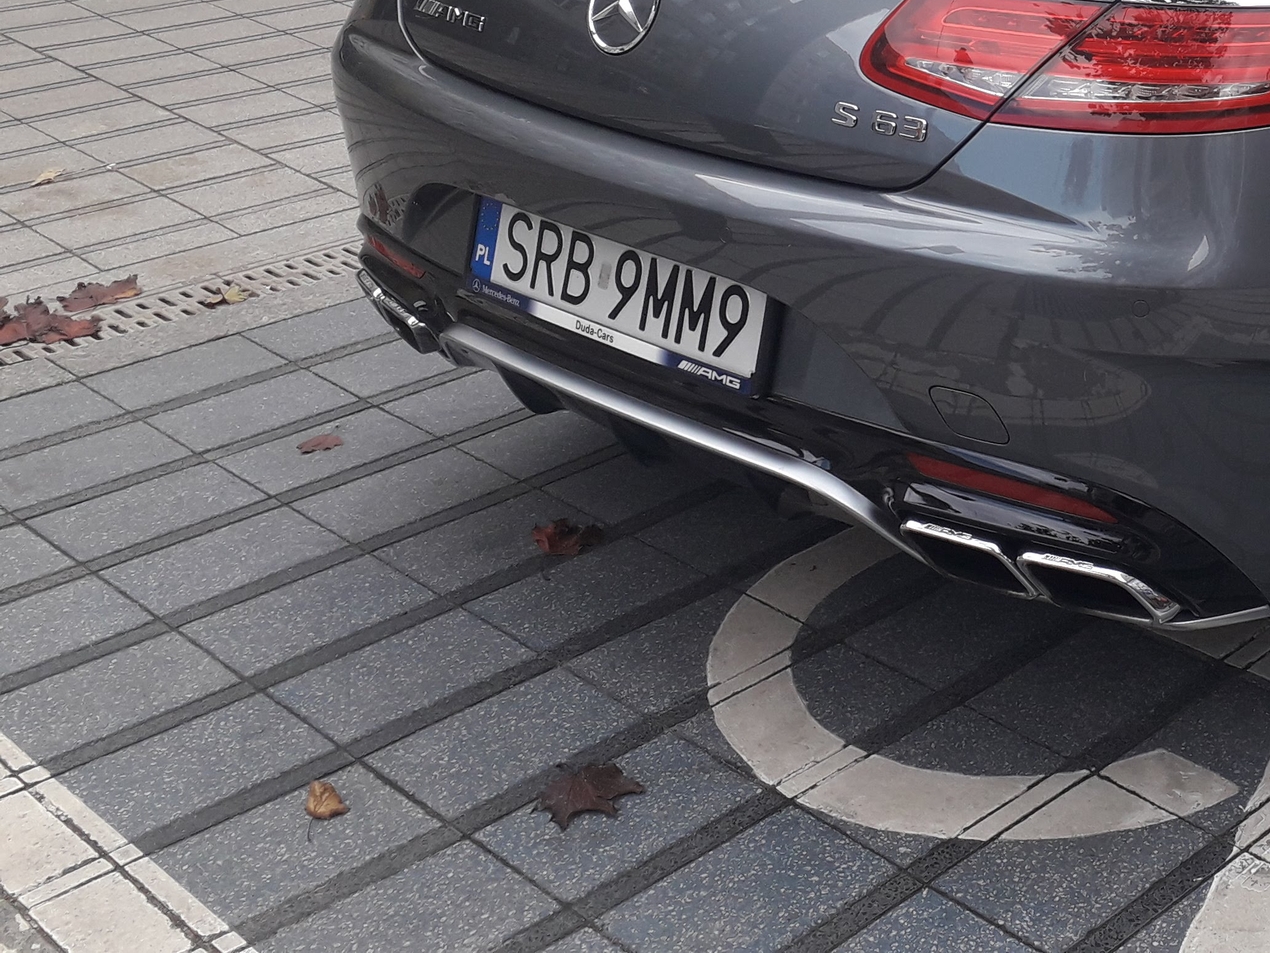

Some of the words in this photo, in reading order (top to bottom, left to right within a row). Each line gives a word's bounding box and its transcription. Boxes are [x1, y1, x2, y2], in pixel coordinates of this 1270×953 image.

[831, 100, 859, 129] S
[873, 109, 929, 143] 63
[474, 243, 492, 267] PL
[481, 284, 521, 308] Mercedes-Benz
[501, 211, 596, 307] SRB
[607, 248, 751, 358] 9MM9
[574, 319, 615, 345] Duda-Cars
[695, 367, 741, 390] AMG
